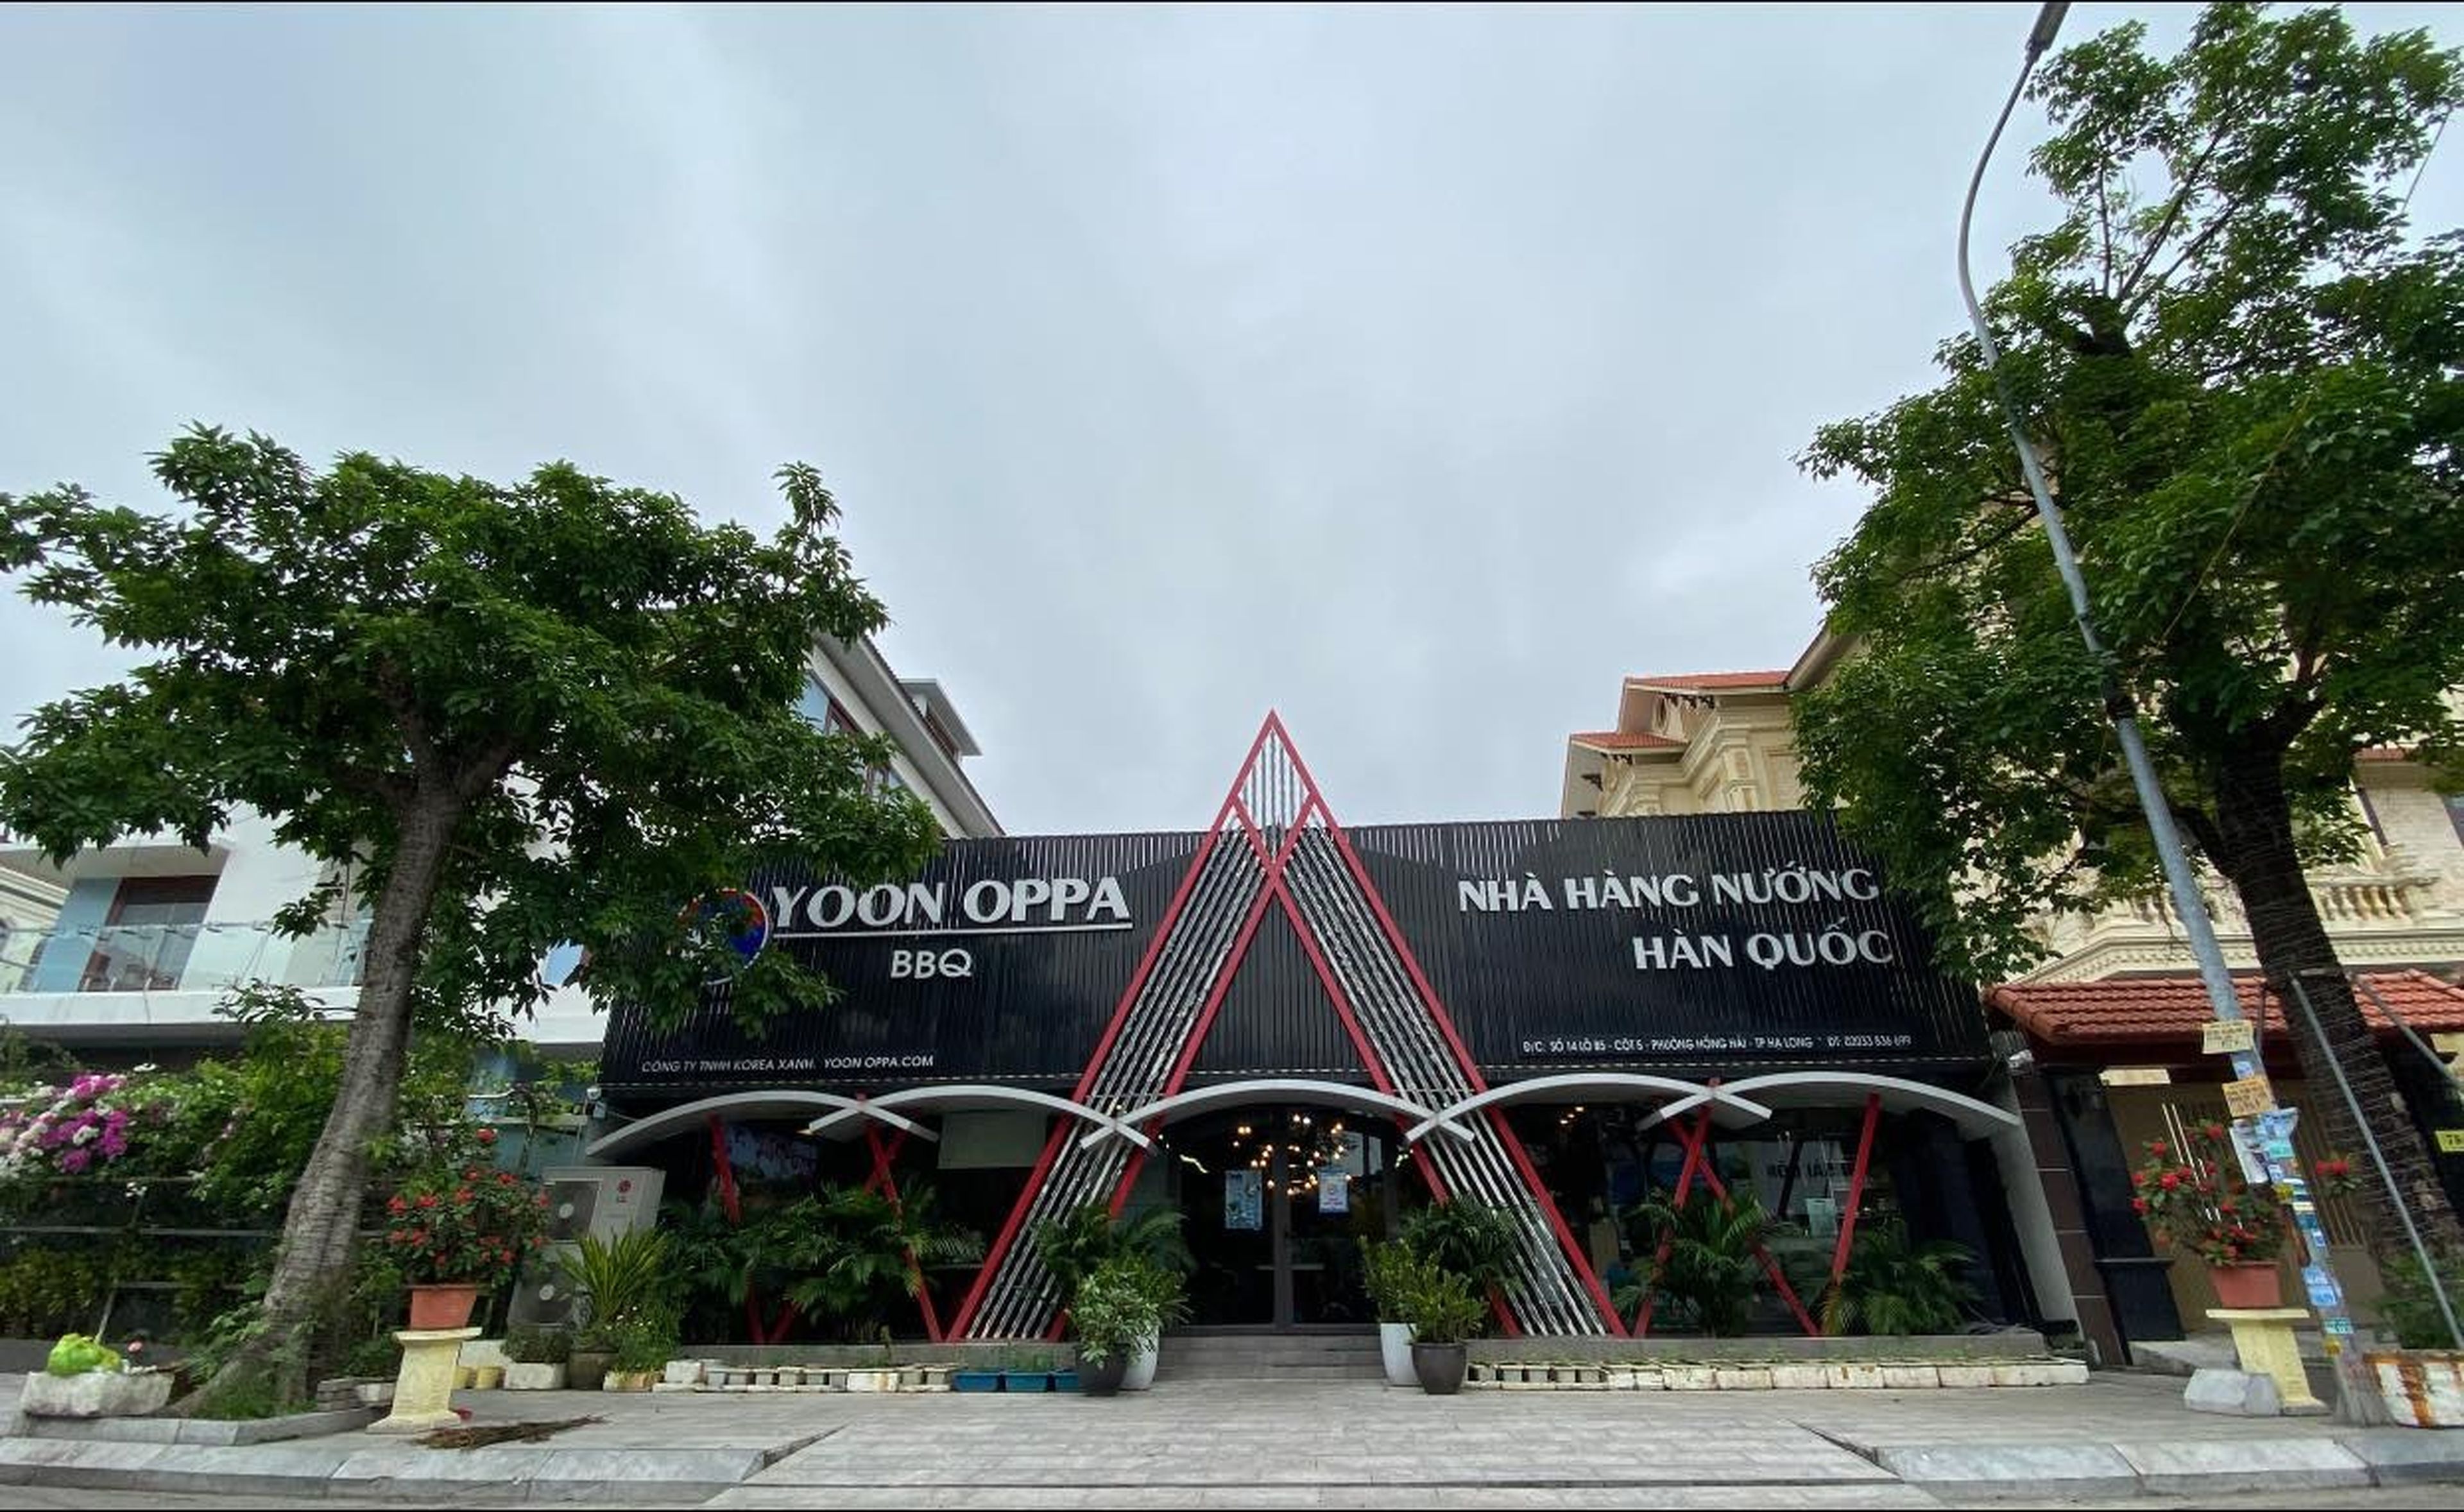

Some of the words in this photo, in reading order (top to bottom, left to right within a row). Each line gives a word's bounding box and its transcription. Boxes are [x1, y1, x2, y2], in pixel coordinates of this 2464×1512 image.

[773, 882, 943, 928] YOON
[963, 876, 1130, 924] OPPA
[1458, 872, 1553, 911] NHÀ
[1563, 868, 1700, 909] HÀNG
[1711, 860, 1879, 906] NƯỚNG
[890, 948, 972, 980] BBQ
[1632, 927, 1733, 970] HÀN
[1746, 916, 1894, 970] QUỐC
[825, 1057, 862, 1069] YOON
